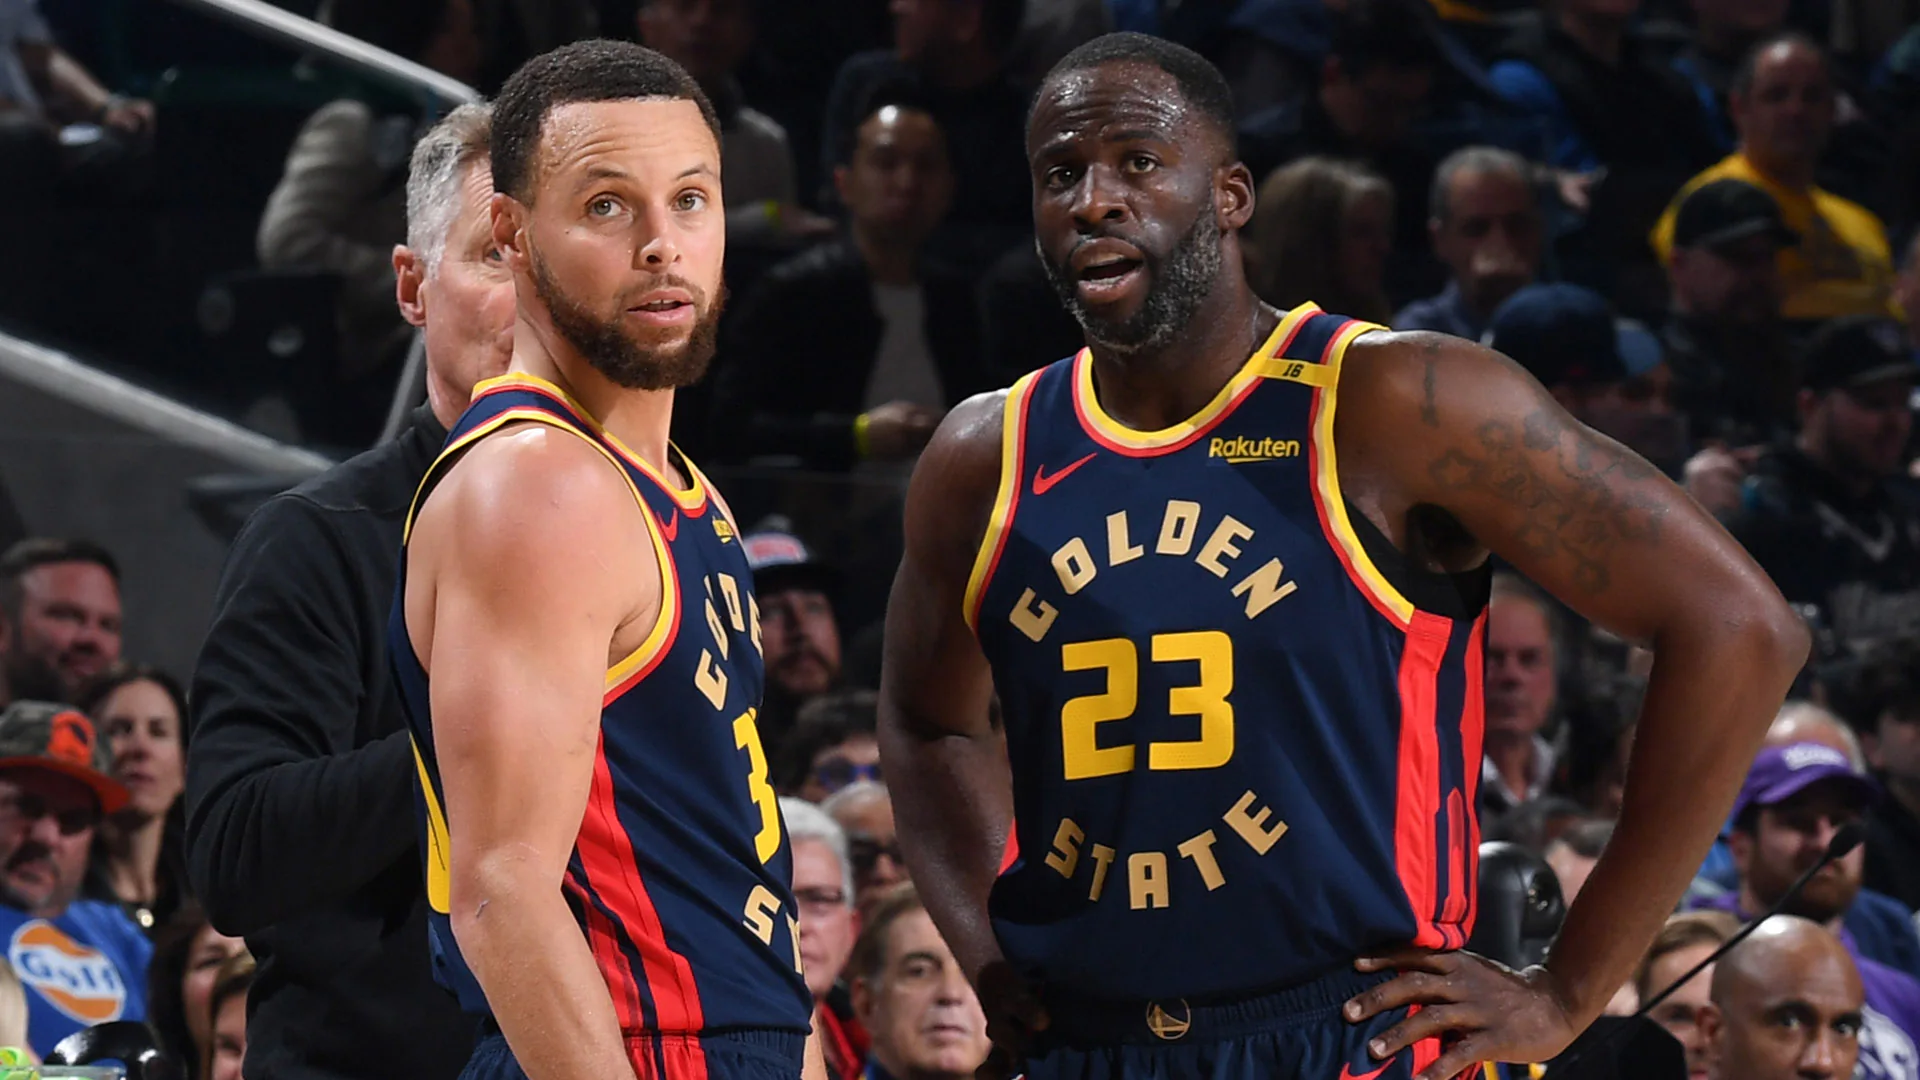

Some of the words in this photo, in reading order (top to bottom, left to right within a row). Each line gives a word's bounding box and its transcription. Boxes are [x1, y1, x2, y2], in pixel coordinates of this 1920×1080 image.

[1282, 362, 1304, 378] 16
[1208, 435, 1300, 459] Rakuten
[1009, 499, 1297, 642] GOLDEN
[694, 572, 764, 712] GODE
[1061, 629, 1235, 781] 23
[732, 706, 781, 866] 3
[1044, 789, 1289, 910] STATE
